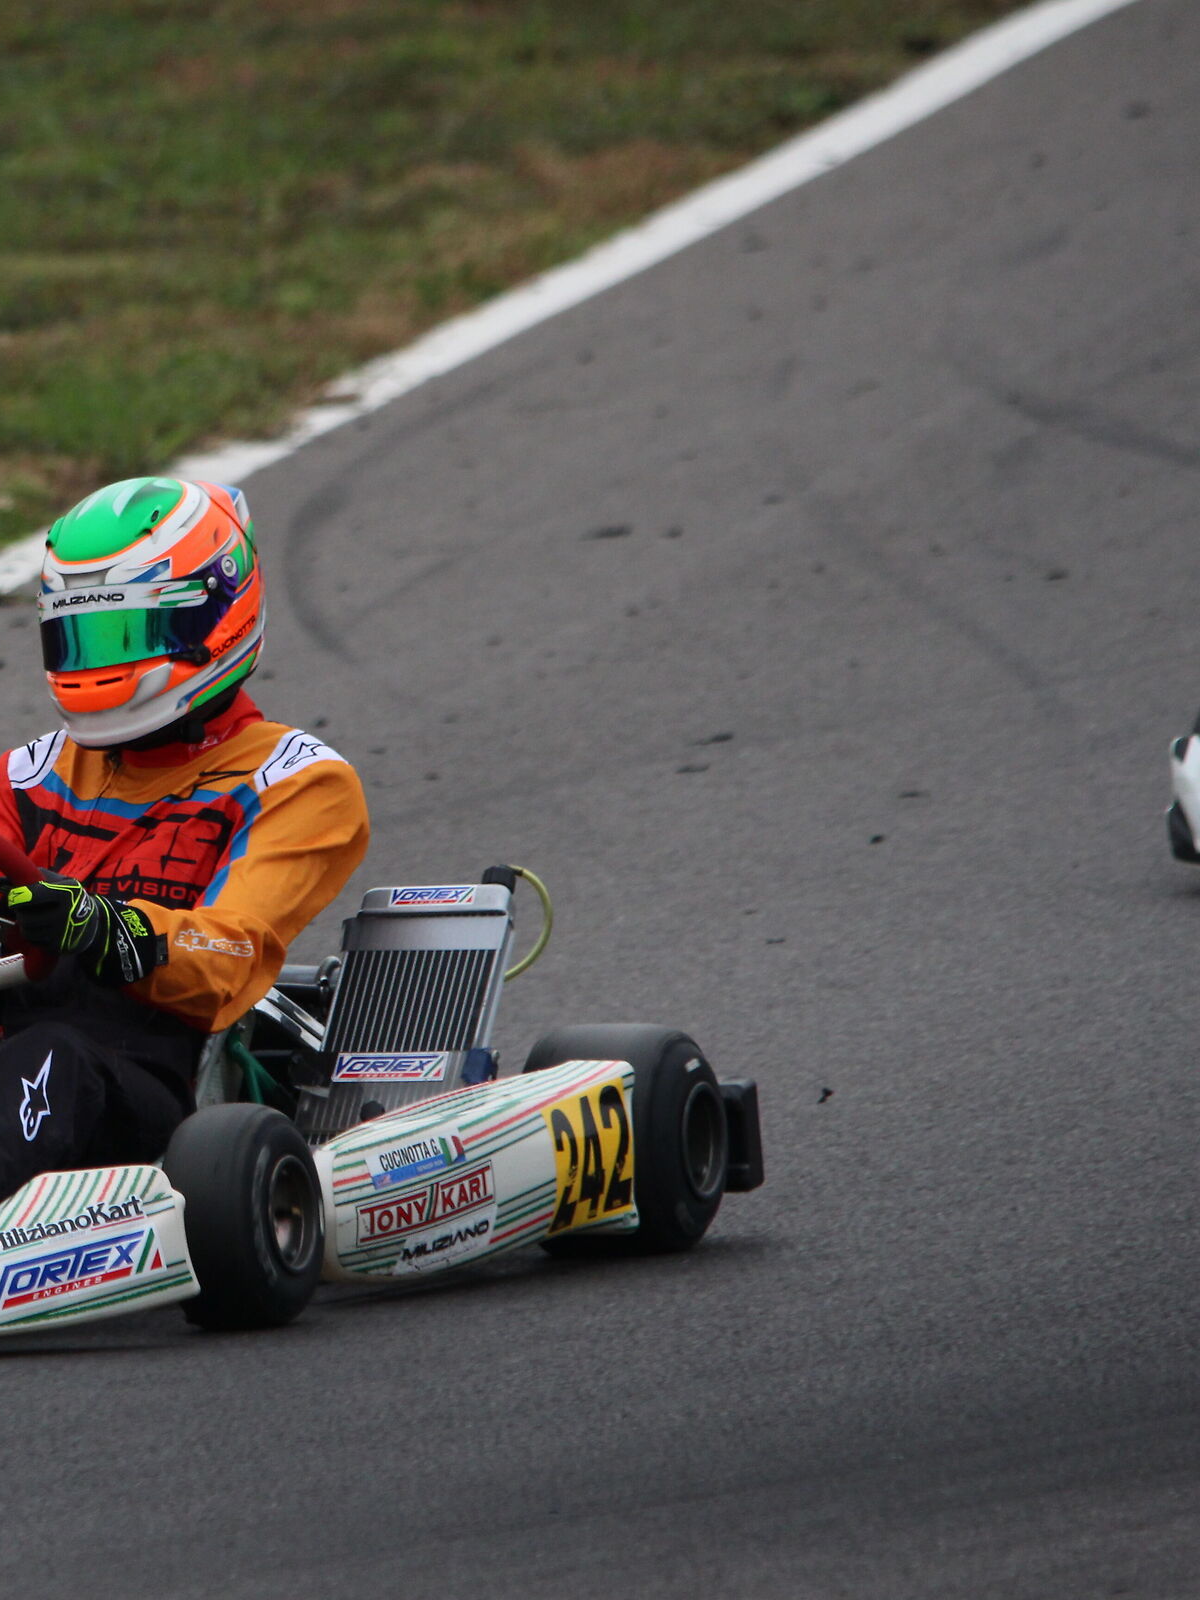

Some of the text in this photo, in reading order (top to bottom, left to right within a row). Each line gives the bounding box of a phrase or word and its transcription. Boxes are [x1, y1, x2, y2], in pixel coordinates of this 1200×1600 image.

[391, 882, 472, 905] VORTEX
[336, 1055, 440, 1077] VORTEX
[379, 1141, 432, 1172] CUCINOTTA
[549, 1085, 633, 1234] 242
[359, 1164, 491, 1235] TONY KART
[32, 1275, 104, 1301] ENGINES
